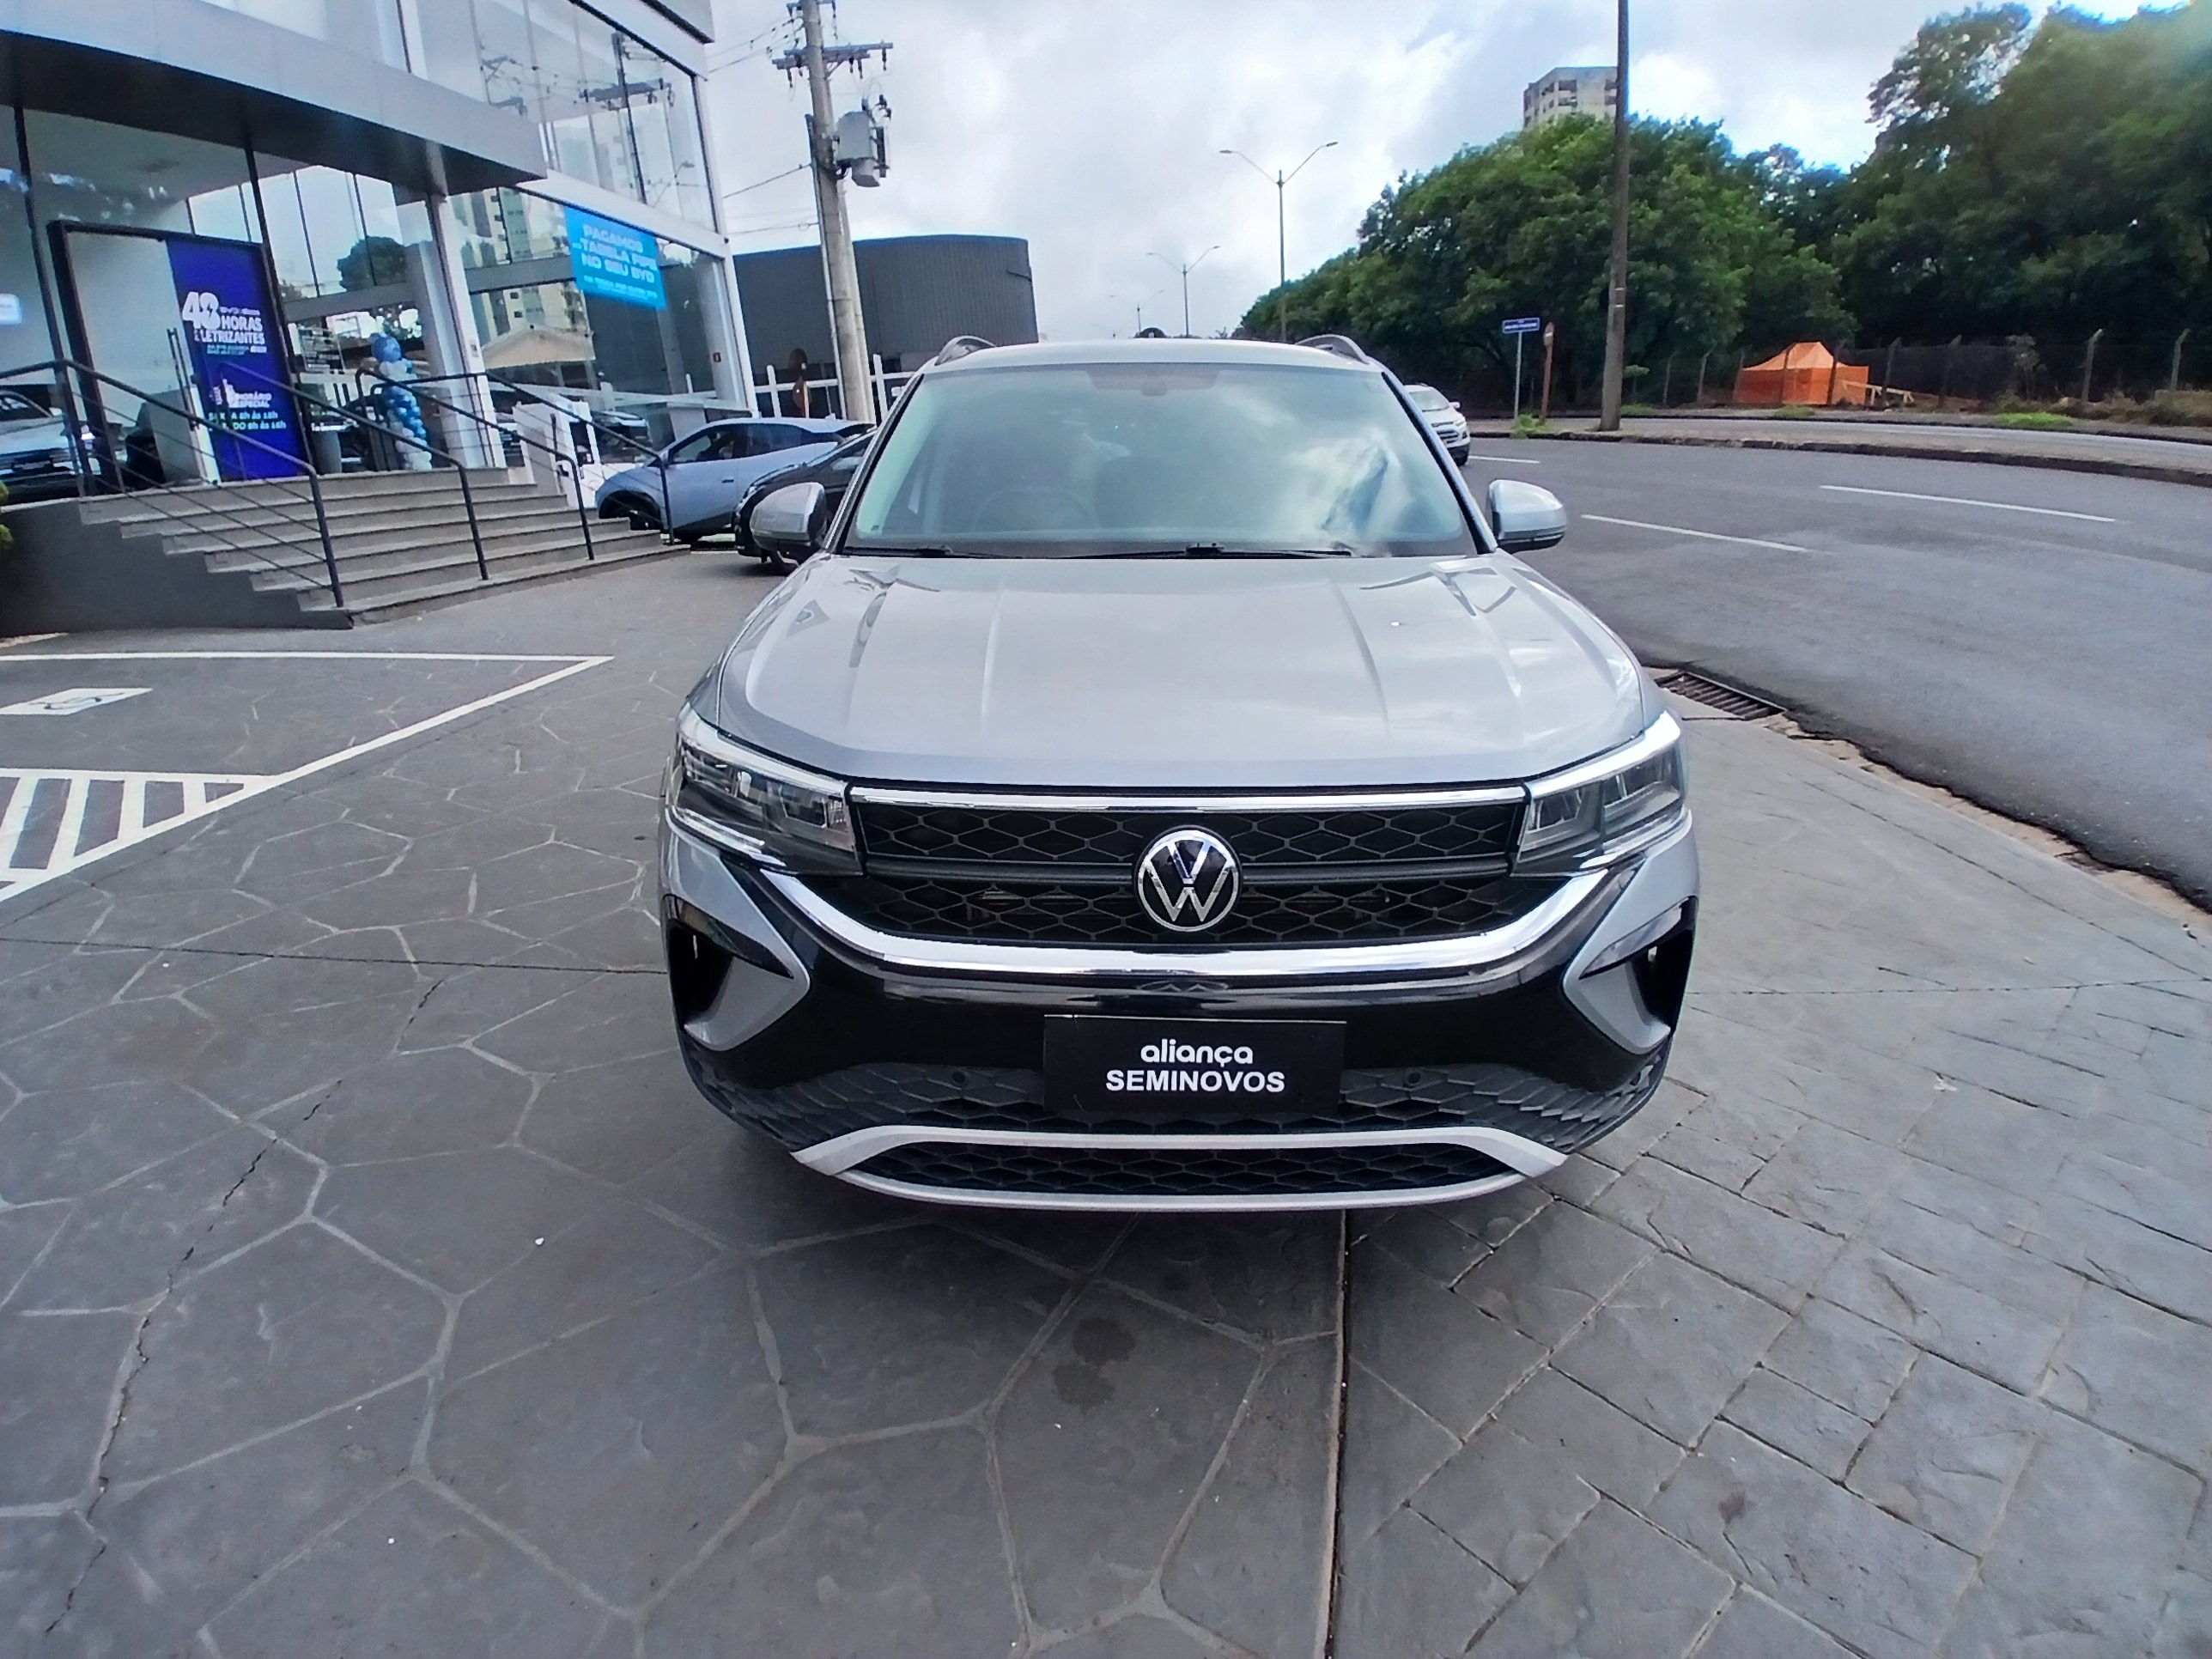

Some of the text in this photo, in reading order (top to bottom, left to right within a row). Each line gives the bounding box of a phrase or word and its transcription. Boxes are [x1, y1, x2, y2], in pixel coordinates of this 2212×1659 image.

[221, 315, 263, 332] HORAS
[1140, 1038, 1254, 1068] aliança
[1105, 1069, 1285, 1093] SEMINOVOS
